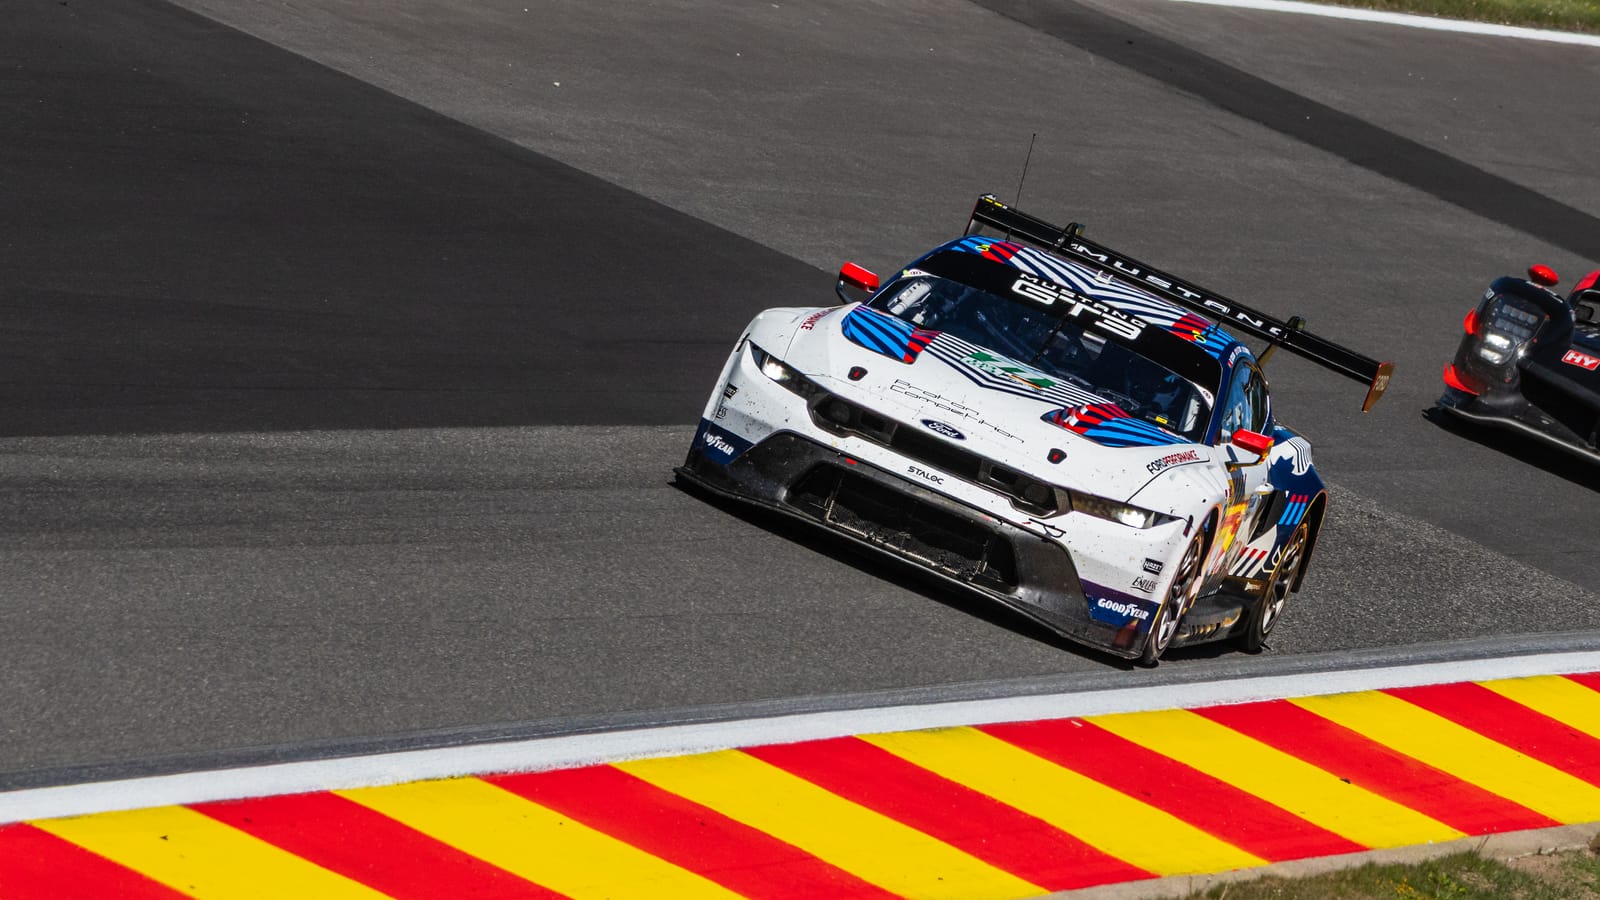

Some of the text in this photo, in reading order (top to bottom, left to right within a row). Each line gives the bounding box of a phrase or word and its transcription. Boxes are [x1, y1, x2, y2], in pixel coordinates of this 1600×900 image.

[1011, 279, 1142, 340] GT3
[1020, 273, 1147, 328] MUSTANG
[1566, 352, 1597, 366] HY
[894, 379, 980, 416] Proton
[890, 384, 1025, 444] Competition
[926, 420, 963, 439] Ford
[907, 465, 944, 485] STALOC
[1097, 598, 1150, 620] GOODYEAR
